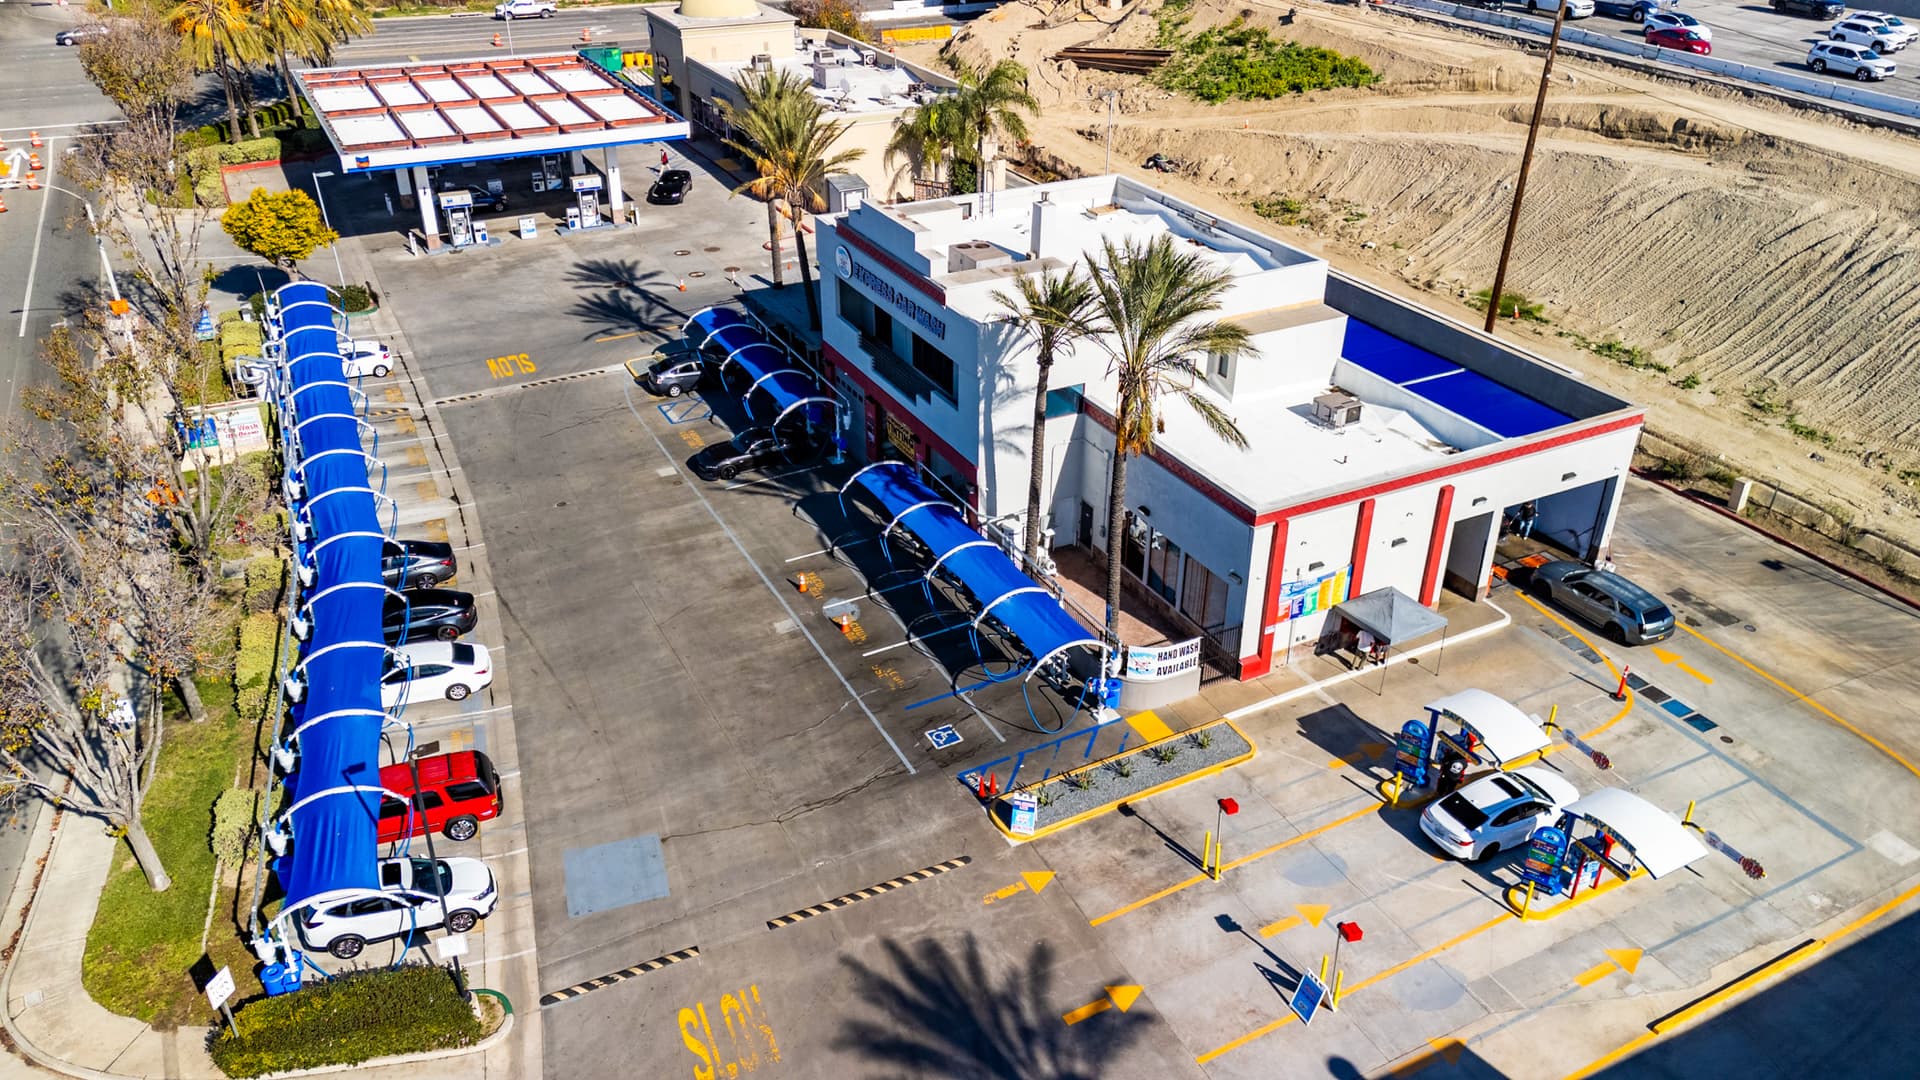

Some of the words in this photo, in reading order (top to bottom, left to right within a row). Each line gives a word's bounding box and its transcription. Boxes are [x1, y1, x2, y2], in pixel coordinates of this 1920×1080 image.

[854, 262, 895, 304] EXPRESS
[896, 292, 917, 320] CAR
[916, 305, 946, 341] WASH
[485, 352, 537, 380] SLOW
[1157, 648, 1178, 662] HAND
[1179, 641, 1199, 657] WASH
[1156, 656, 1197, 676] AVAILABLE
